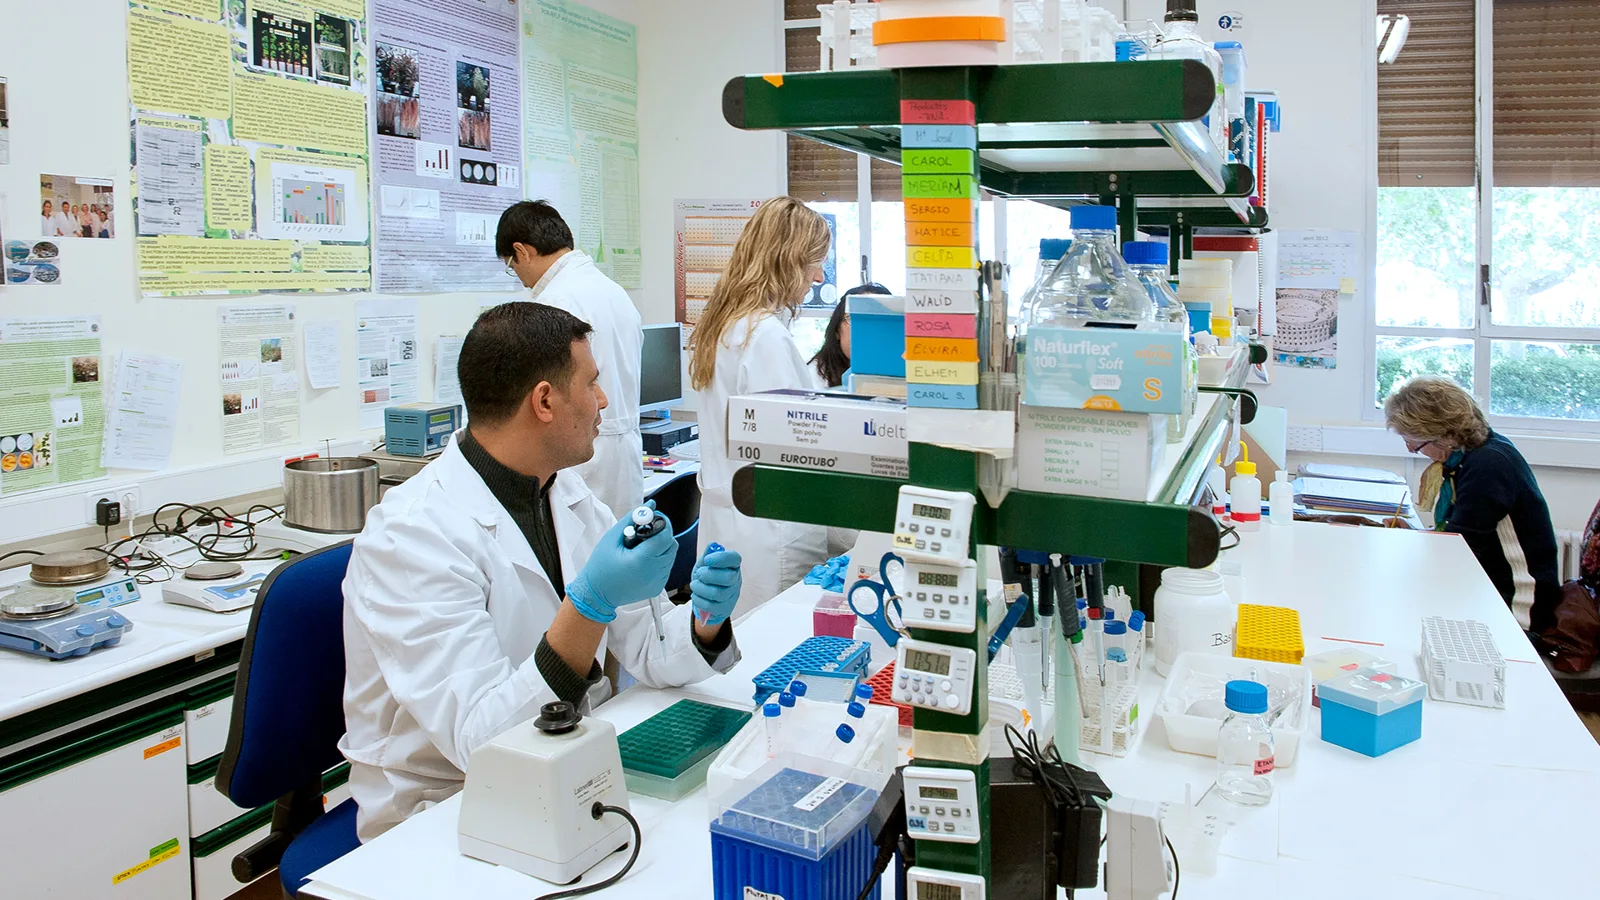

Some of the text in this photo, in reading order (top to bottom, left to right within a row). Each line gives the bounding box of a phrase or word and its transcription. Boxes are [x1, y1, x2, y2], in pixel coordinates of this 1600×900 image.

[912, 156, 952, 166] CAROL
[912, 205, 950, 214] SERGIO
[915, 228, 960, 237] HATICE
[914, 321, 952, 331] ROSA
[1035, 356, 1056, 368] 100
[1097, 357, 1124, 370] Soft
[914, 366, 958, 378] ELHEM
[1143, 378, 1162, 401] S
[914, 390, 948, 400] CAROL
[745, 408, 755, 420] M
[787, 410, 828, 422] NITRILE
[788, 420, 811, 429] Powder
[1058, 415, 1105, 426] DISPOSABLE
[1107, 420, 1138, 428] GLOVES
[742, 422, 757, 432] 7/8
[878, 424, 907, 438] delt
[804, 429, 822, 437] polvo
[737, 446, 761, 460] 100
[871, 456, 905, 464] Examination
